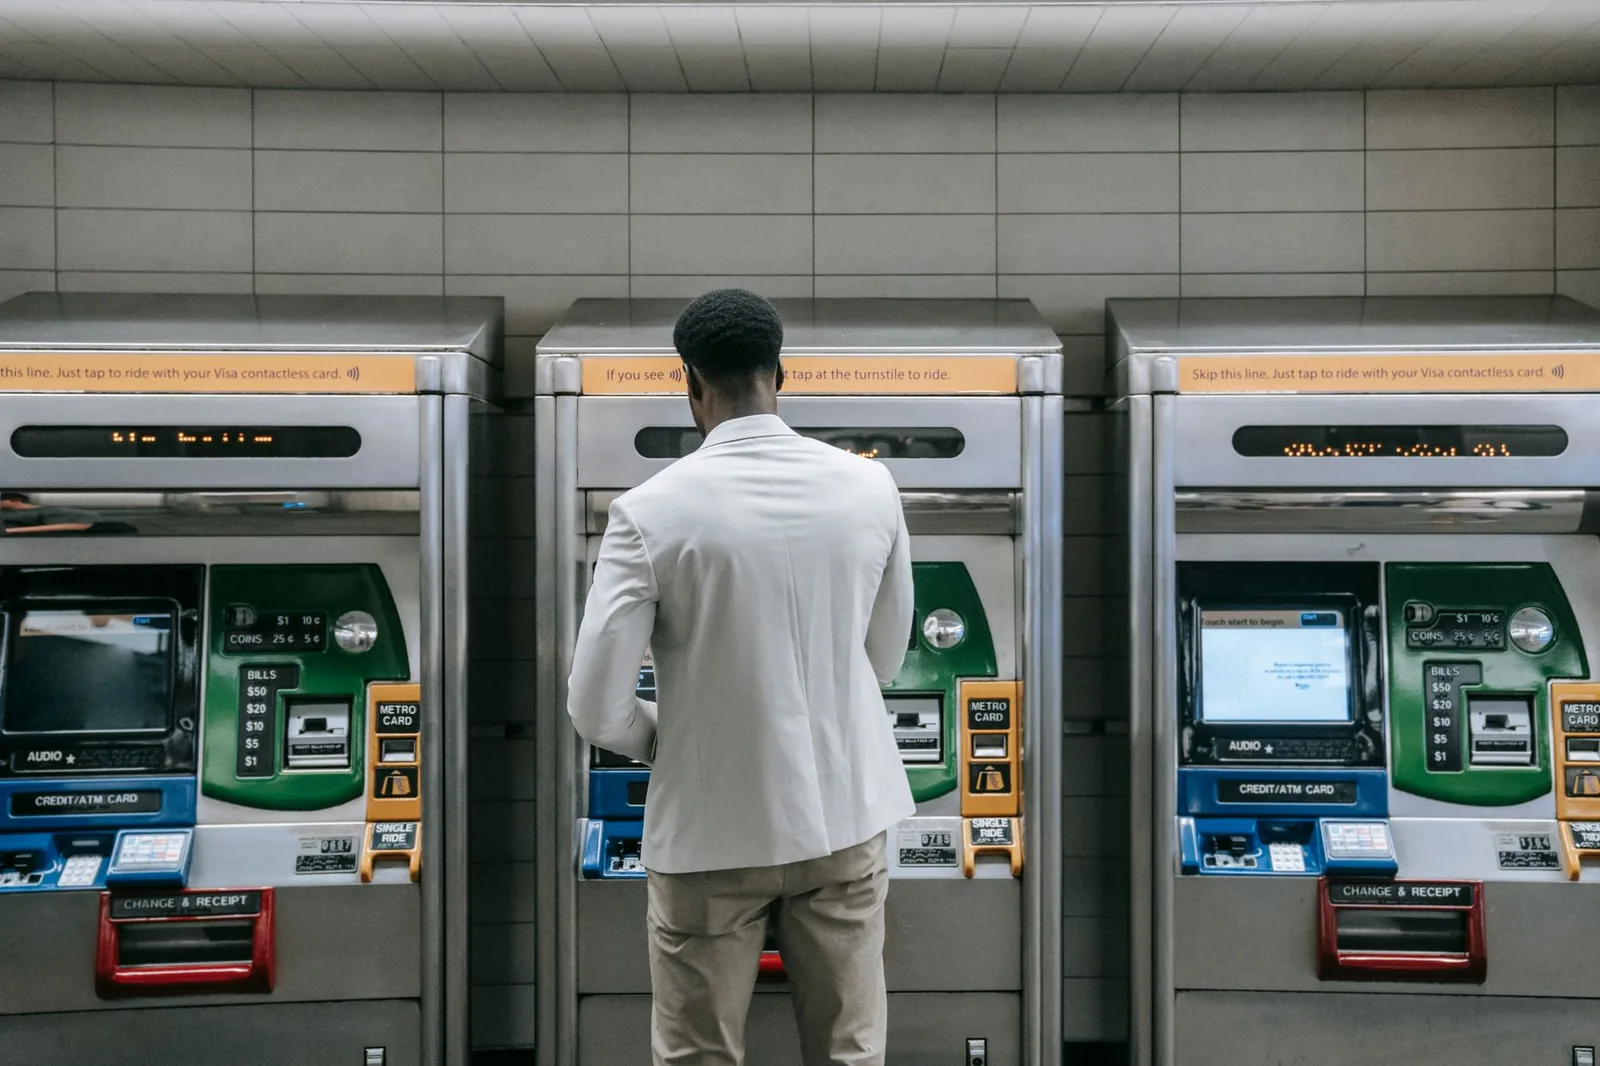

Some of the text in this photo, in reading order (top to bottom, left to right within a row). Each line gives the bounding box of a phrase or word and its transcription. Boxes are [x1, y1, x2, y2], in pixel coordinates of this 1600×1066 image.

[0, 367, 342, 381] this line. Just tap to ride with your Visa contactless card.
[606, 369, 664, 383] If you see
[792, 370, 812, 383] tap
[815, 370, 827, 380] at
[831, 369, 851, 380] the
[854, 369, 905, 380] turnstile
[908, 370, 921, 380] to
[924, 369, 951, 380] ride.
[1192, 367, 1546, 381] Skip this line. Just tap to ride with your Visa contactless card.
[277, 615, 289, 626] $1
[1228, 618, 1248, 626] start
[1250, 618, 1258, 626] to
[1260, 617, 1284, 628] begin
[1456, 613, 1468, 623] $1
[230, 634, 263, 644] COINS
[1412, 631, 1444, 641] COINS
[247, 670, 277, 680] BILLS
[1431, 666, 1460, 676] BILLS
[247, 686, 267, 697] $50
[1432, 682, 1451, 693] $50
[246, 703, 266, 714] $20
[380, 705, 417, 715] METRO
[971, 701, 1007, 711] METRO
[1432, 700, 1452, 710] $20
[1564, 704, 1600, 714] METRO
[382, 716, 413, 726] CARD
[975, 712, 1004, 722] CARD
[1433, 716, 1451, 727] $10
[1568, 715, 1599, 725] CARD
[245, 721, 264, 732] $10
[245, 738, 259, 749] $5
[1434, 733, 1447, 744] $5
[1229, 740, 1261, 751] AUDIO
[27, 751, 62, 762] AUDIO
[244, 755, 257, 767] $1
[1434, 751, 1446, 762] $1
[1239, 784, 1335, 795] CREDIT/ATM CARD
[35, 793, 138, 806] CREDIT/ATM CARD
[375, 823, 413, 833] SINGLE
[972, 818, 1009, 828] SINGLE
[381, 833, 407, 843] RIDE
[980, 829, 1004, 838] RIDE
[1581, 832, 1600, 842] RID
[922, 834, 950, 845] 0785
[321, 840, 352, 851] 0697
[1343, 886, 1461, 897] CHANGE & RECEIPT
[124, 895, 248, 910] CHANGE & RECEIPT
